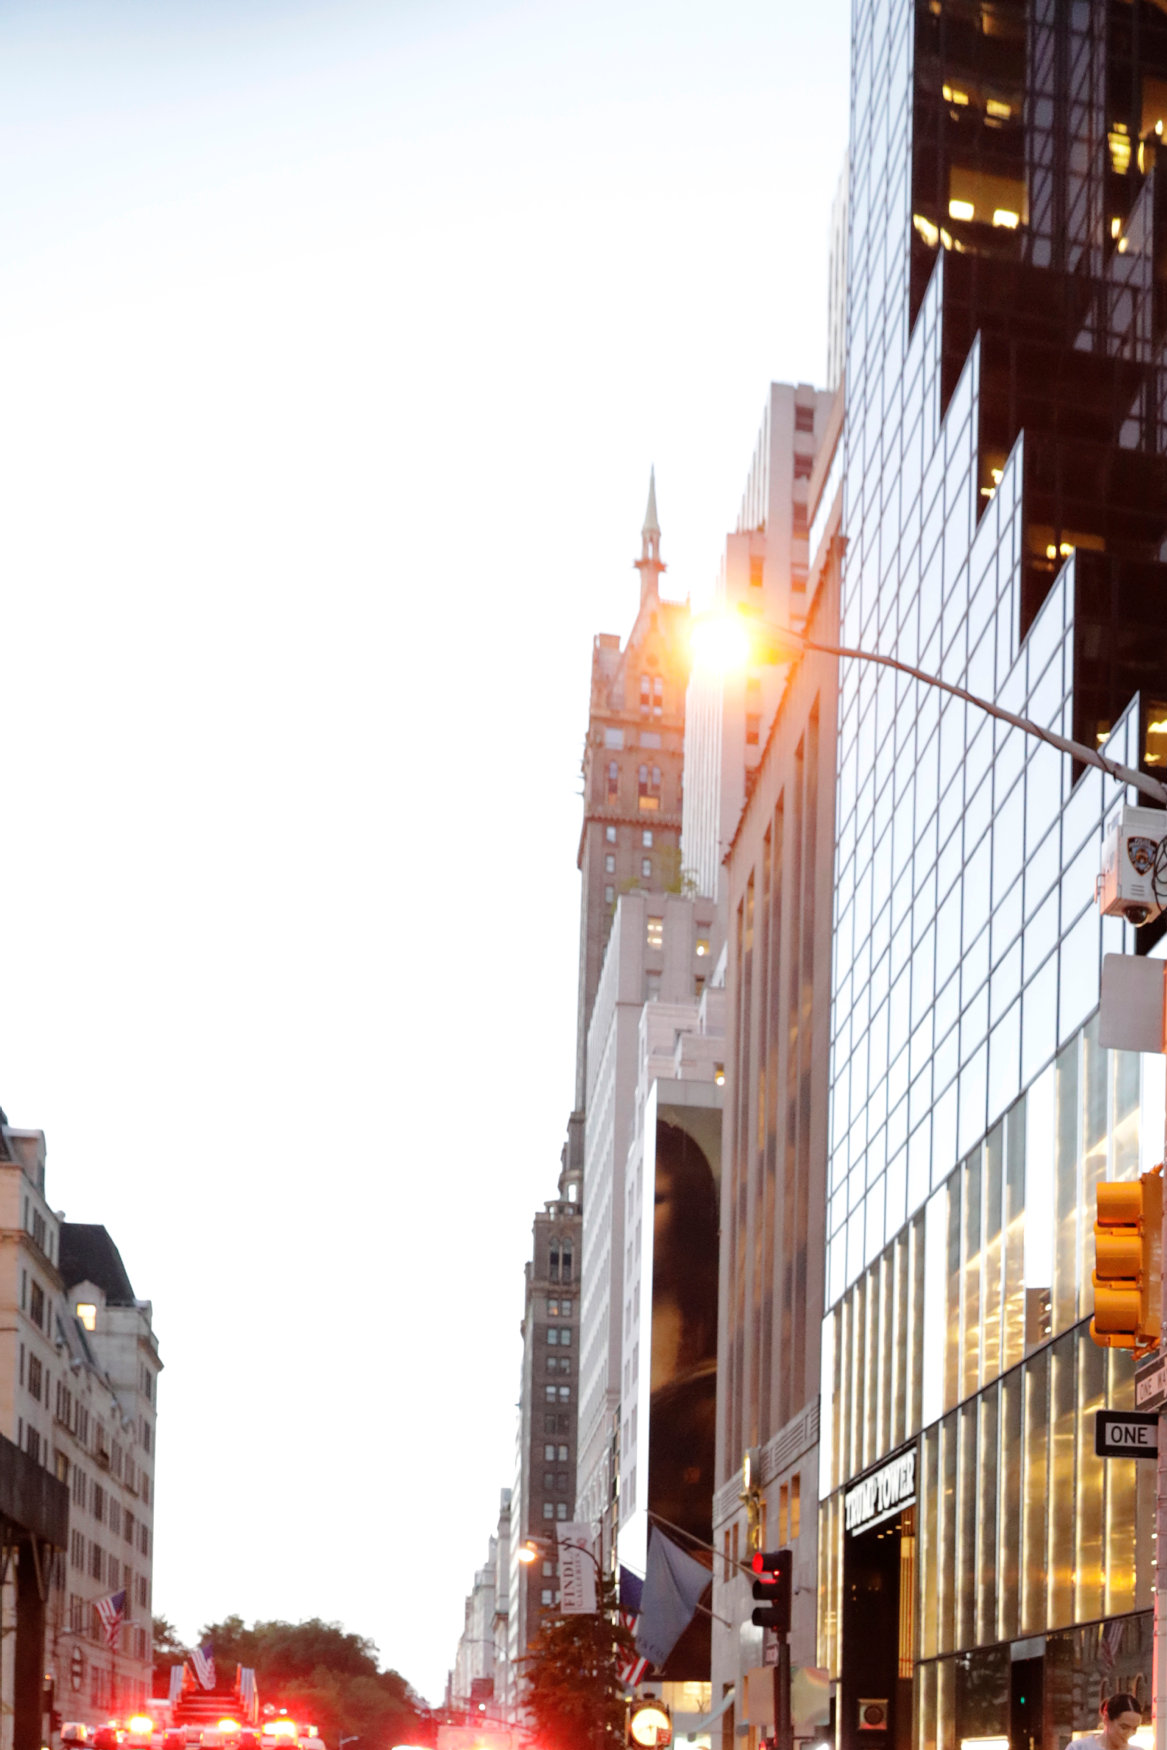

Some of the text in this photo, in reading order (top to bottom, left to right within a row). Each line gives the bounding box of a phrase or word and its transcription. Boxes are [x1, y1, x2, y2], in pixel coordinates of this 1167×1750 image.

[1140, 1378, 1153, 1401] ONE
[1110, 1425, 1148, 1445] ONE
[845, 1452, 915, 1531] TRUMP TOWER
[563, 1537, 576, 1608] FINDLY
